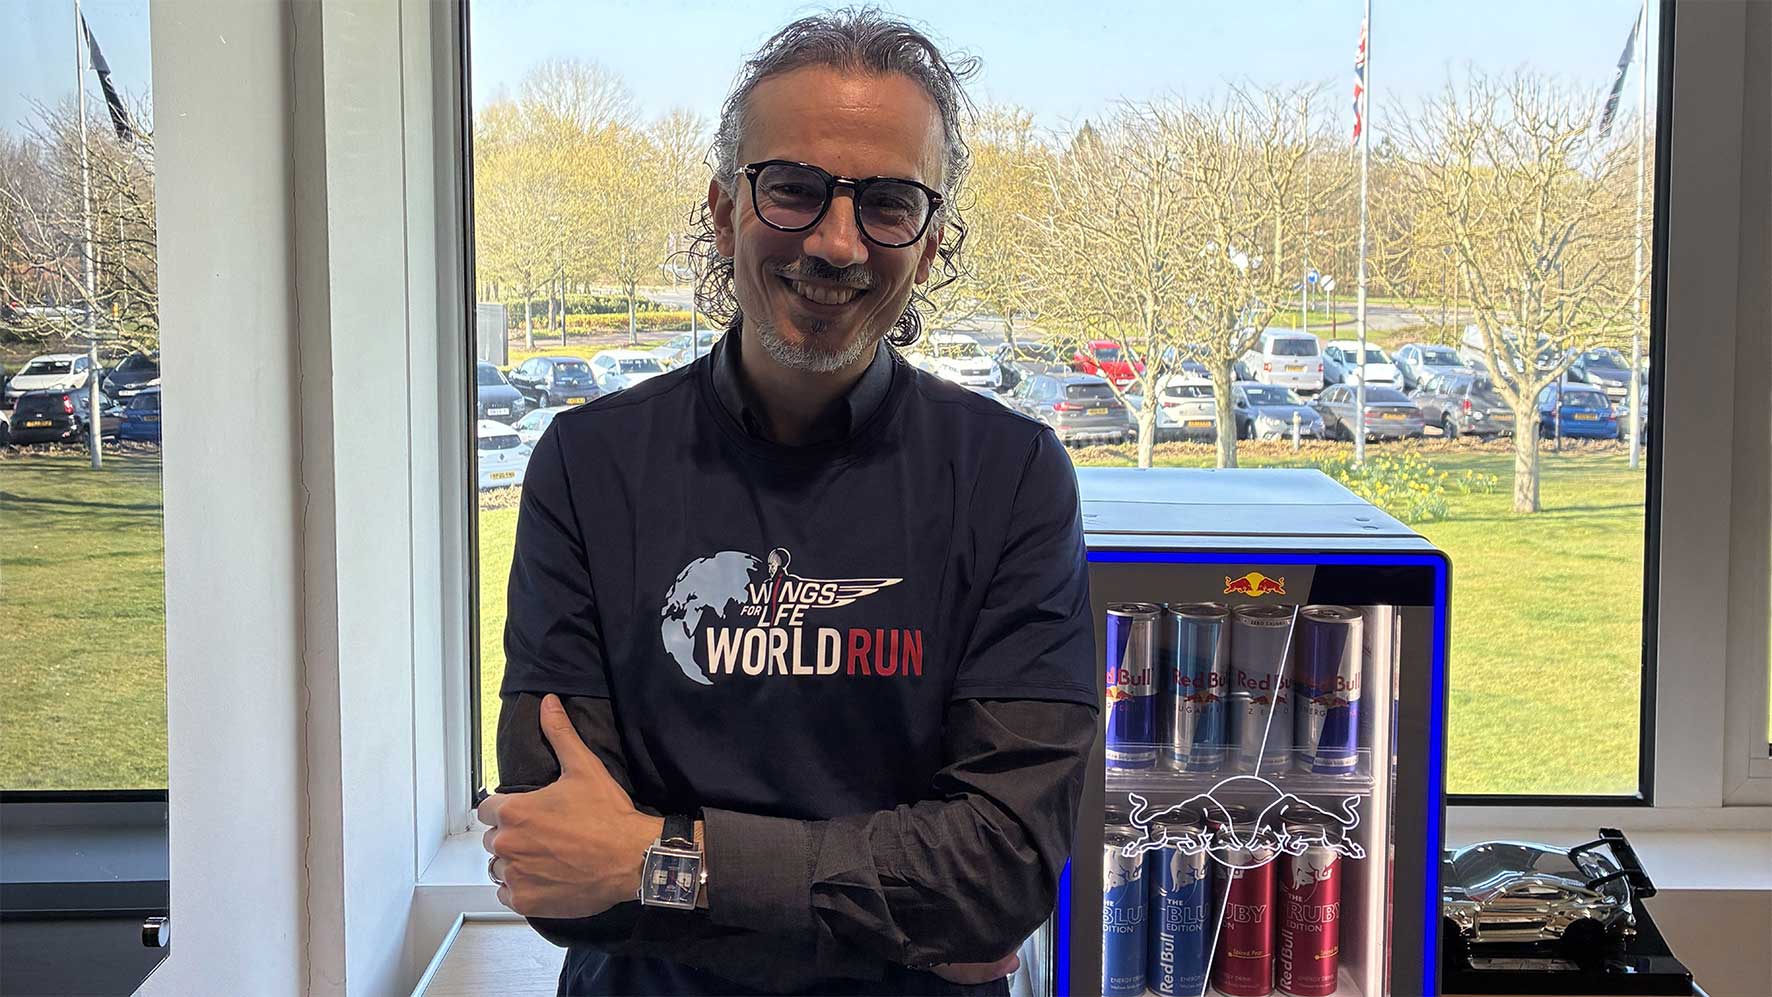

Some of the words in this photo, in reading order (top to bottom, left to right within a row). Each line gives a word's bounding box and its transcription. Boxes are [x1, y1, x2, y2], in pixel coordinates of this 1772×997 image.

[749, 581, 838, 604] WINGS
[740, 605, 761, 616] FOR
[706, 627, 842, 676] WORLD
[847, 628, 923, 676] RUN
[1118, 667, 1151, 686] Bull
[1208, 672, 1226, 688] Bu
[1237, 671, 1271, 690] Red
[1274, 674, 1290, 690] Bu
[1336, 672, 1361, 691] Bull
[1248, 707, 1289, 716] ZEO
[1167, 898, 1184, 906] THE
[1288, 894, 1302, 902] THE
[1103, 906, 1144, 926] BLU
[1166, 903, 1209, 924] BLU
[1226, 902, 1267, 924] UBY
[1103, 925, 1134, 934] DITION
[1166, 923, 1202, 932] EDITION
[1160, 932, 1174, 962] Bull
[1281, 928, 1294, 961] Bull
[1160, 962, 1174, 993] Red
[1280, 960, 1293, 990] Red
